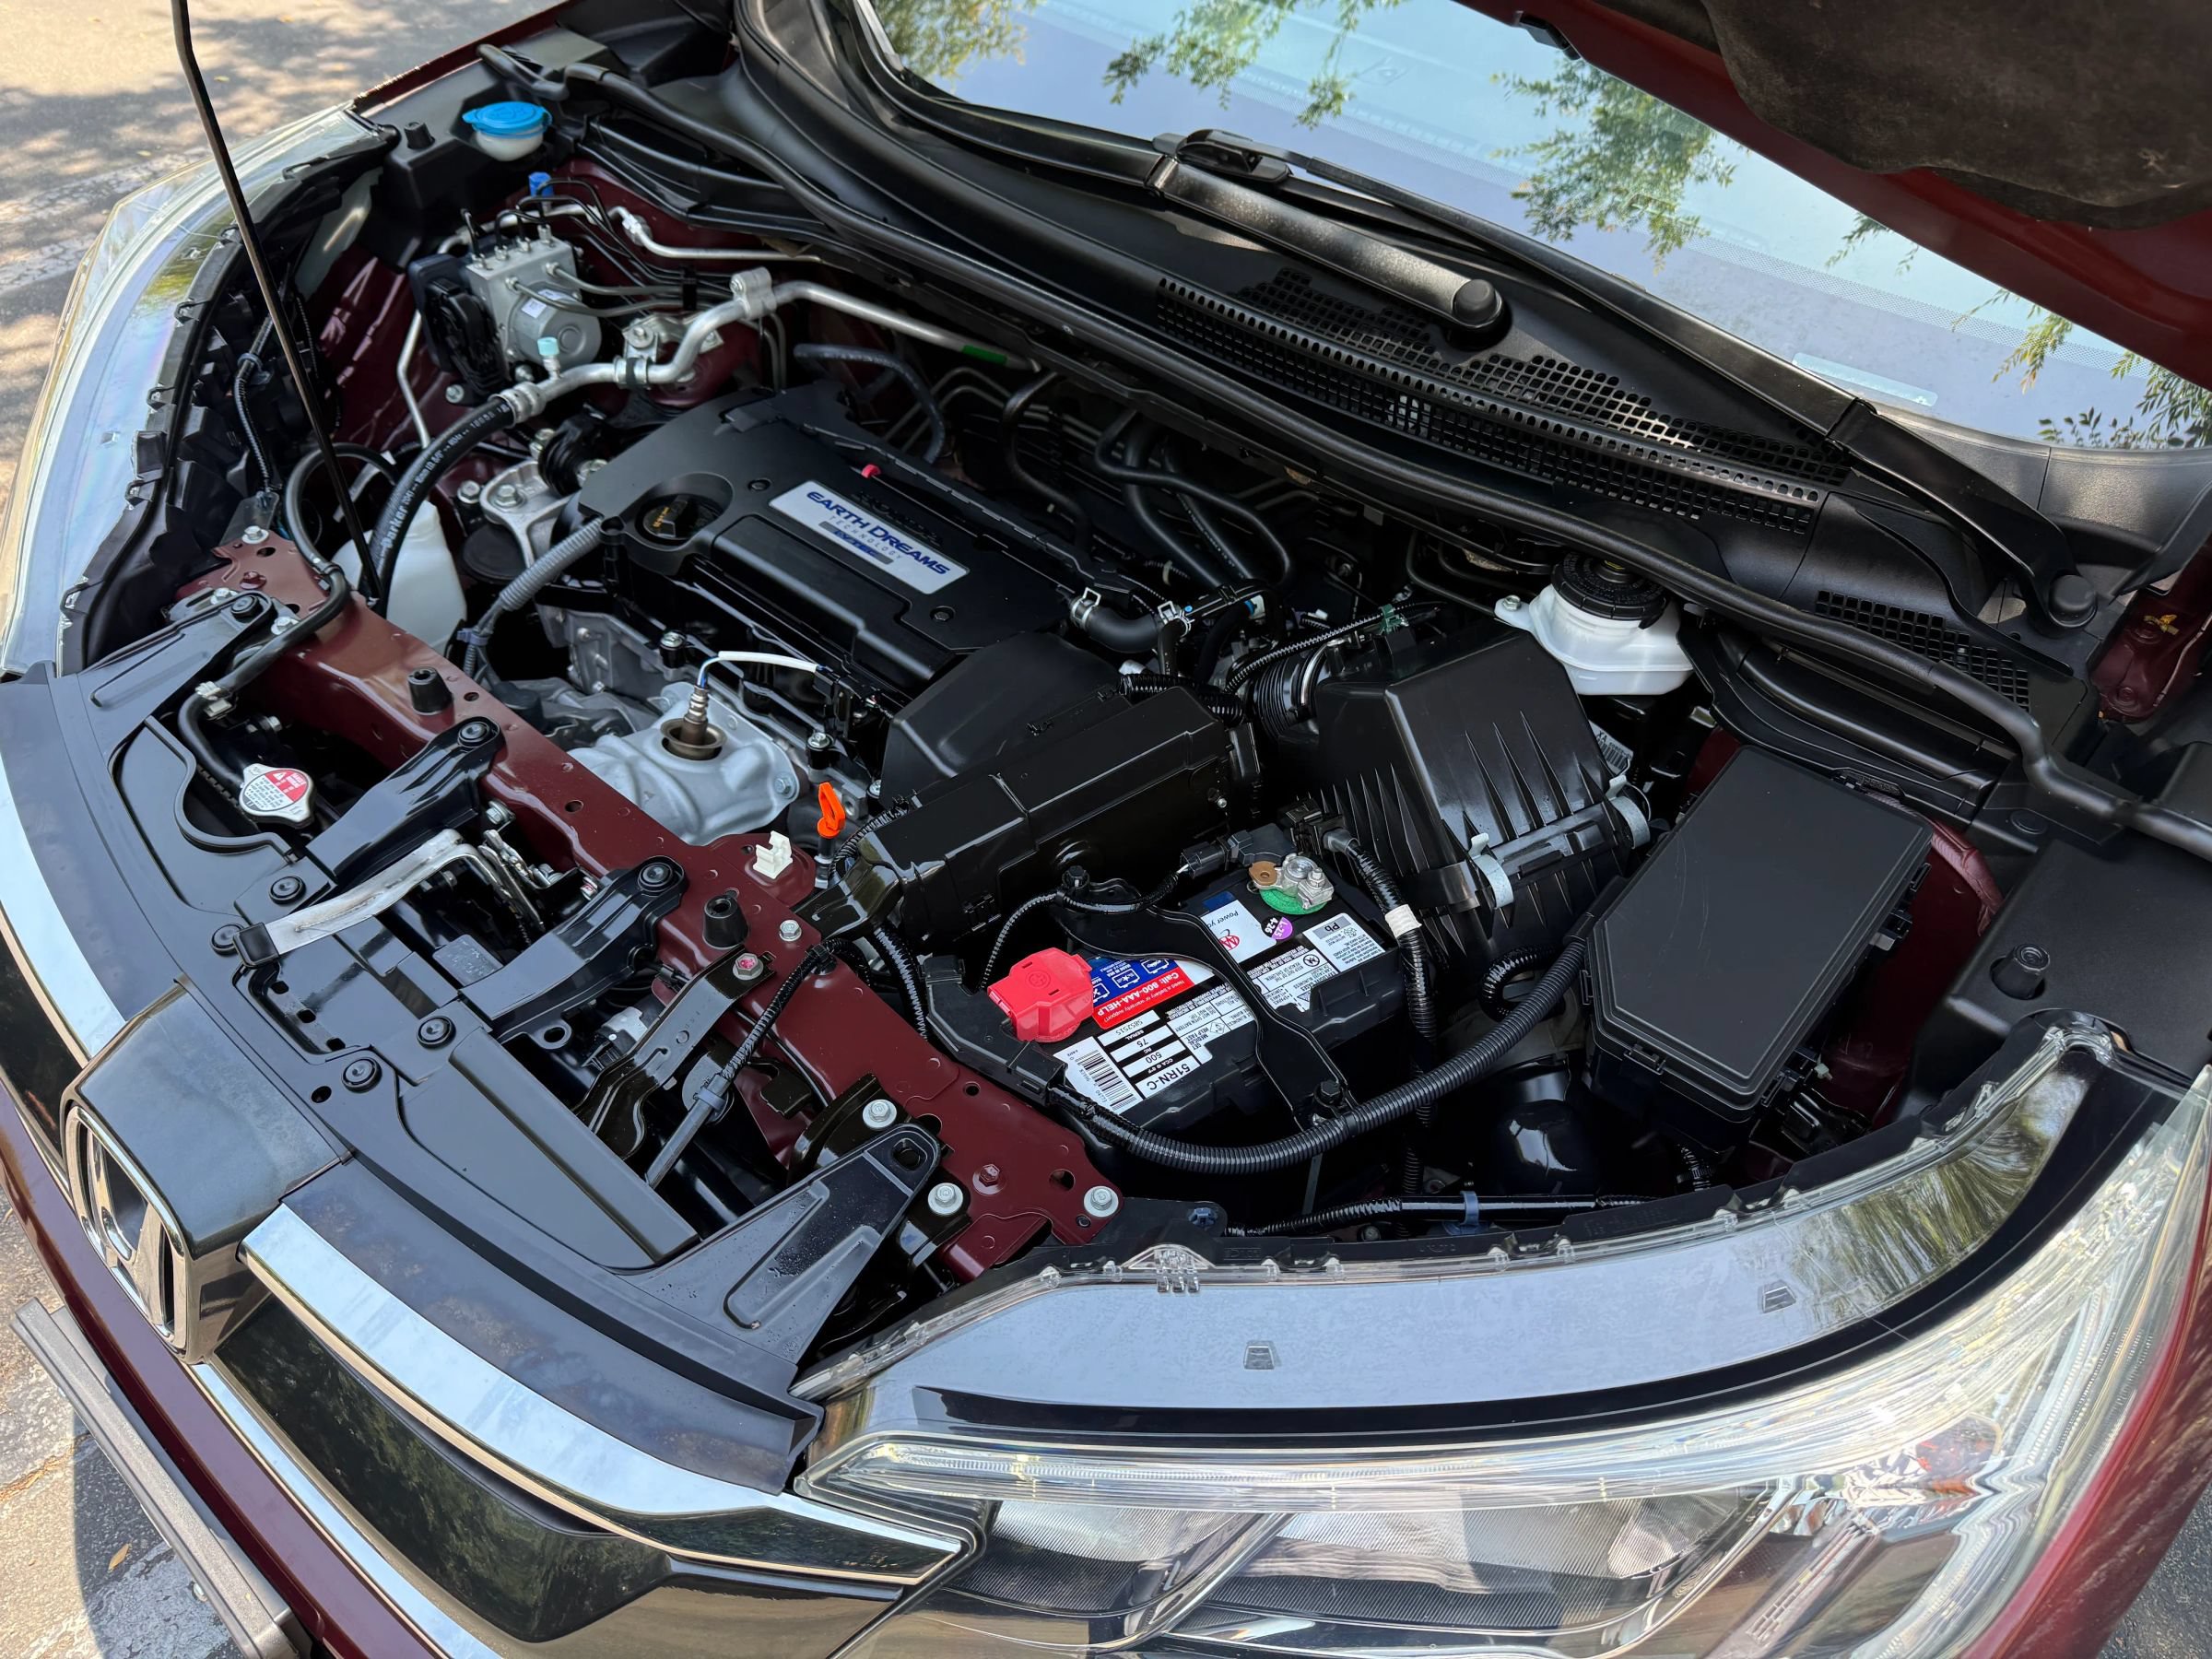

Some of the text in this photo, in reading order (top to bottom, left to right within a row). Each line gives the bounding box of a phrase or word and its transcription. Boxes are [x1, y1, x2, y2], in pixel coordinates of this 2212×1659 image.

[380, 505, 408, 549] Parker
[806, 491, 950, 575] EARTH DREAMS
[829, 515, 903, 560] TECHNOLOGY
[1206, 910, 1239, 928] Power yo
[1263, 916, 1279, 935] 4-26
[1324, 922, 1340, 932] Pb
[1171, 979, 1184, 988] Need
[1300, 982, 1314, 991] GASES
[1096, 971, 1179, 1017] Call: 800-AAA-HELP
[1149, 986, 1168, 999] battery
[1123, 997, 1145, 1011] warranty
[1124, 1029, 1144, 1041] SERIAL
[1183, 1026, 1208, 1041] HELP FAST.
[1187, 1032, 1208, 1045] MEDICAL
[1135, 1037, 1148, 1047] 75
[1144, 1051, 1162, 1064] 500
[1160, 1057, 1173, 1066] CCA
[1145, 1063, 1190, 1090] 51RN-C
